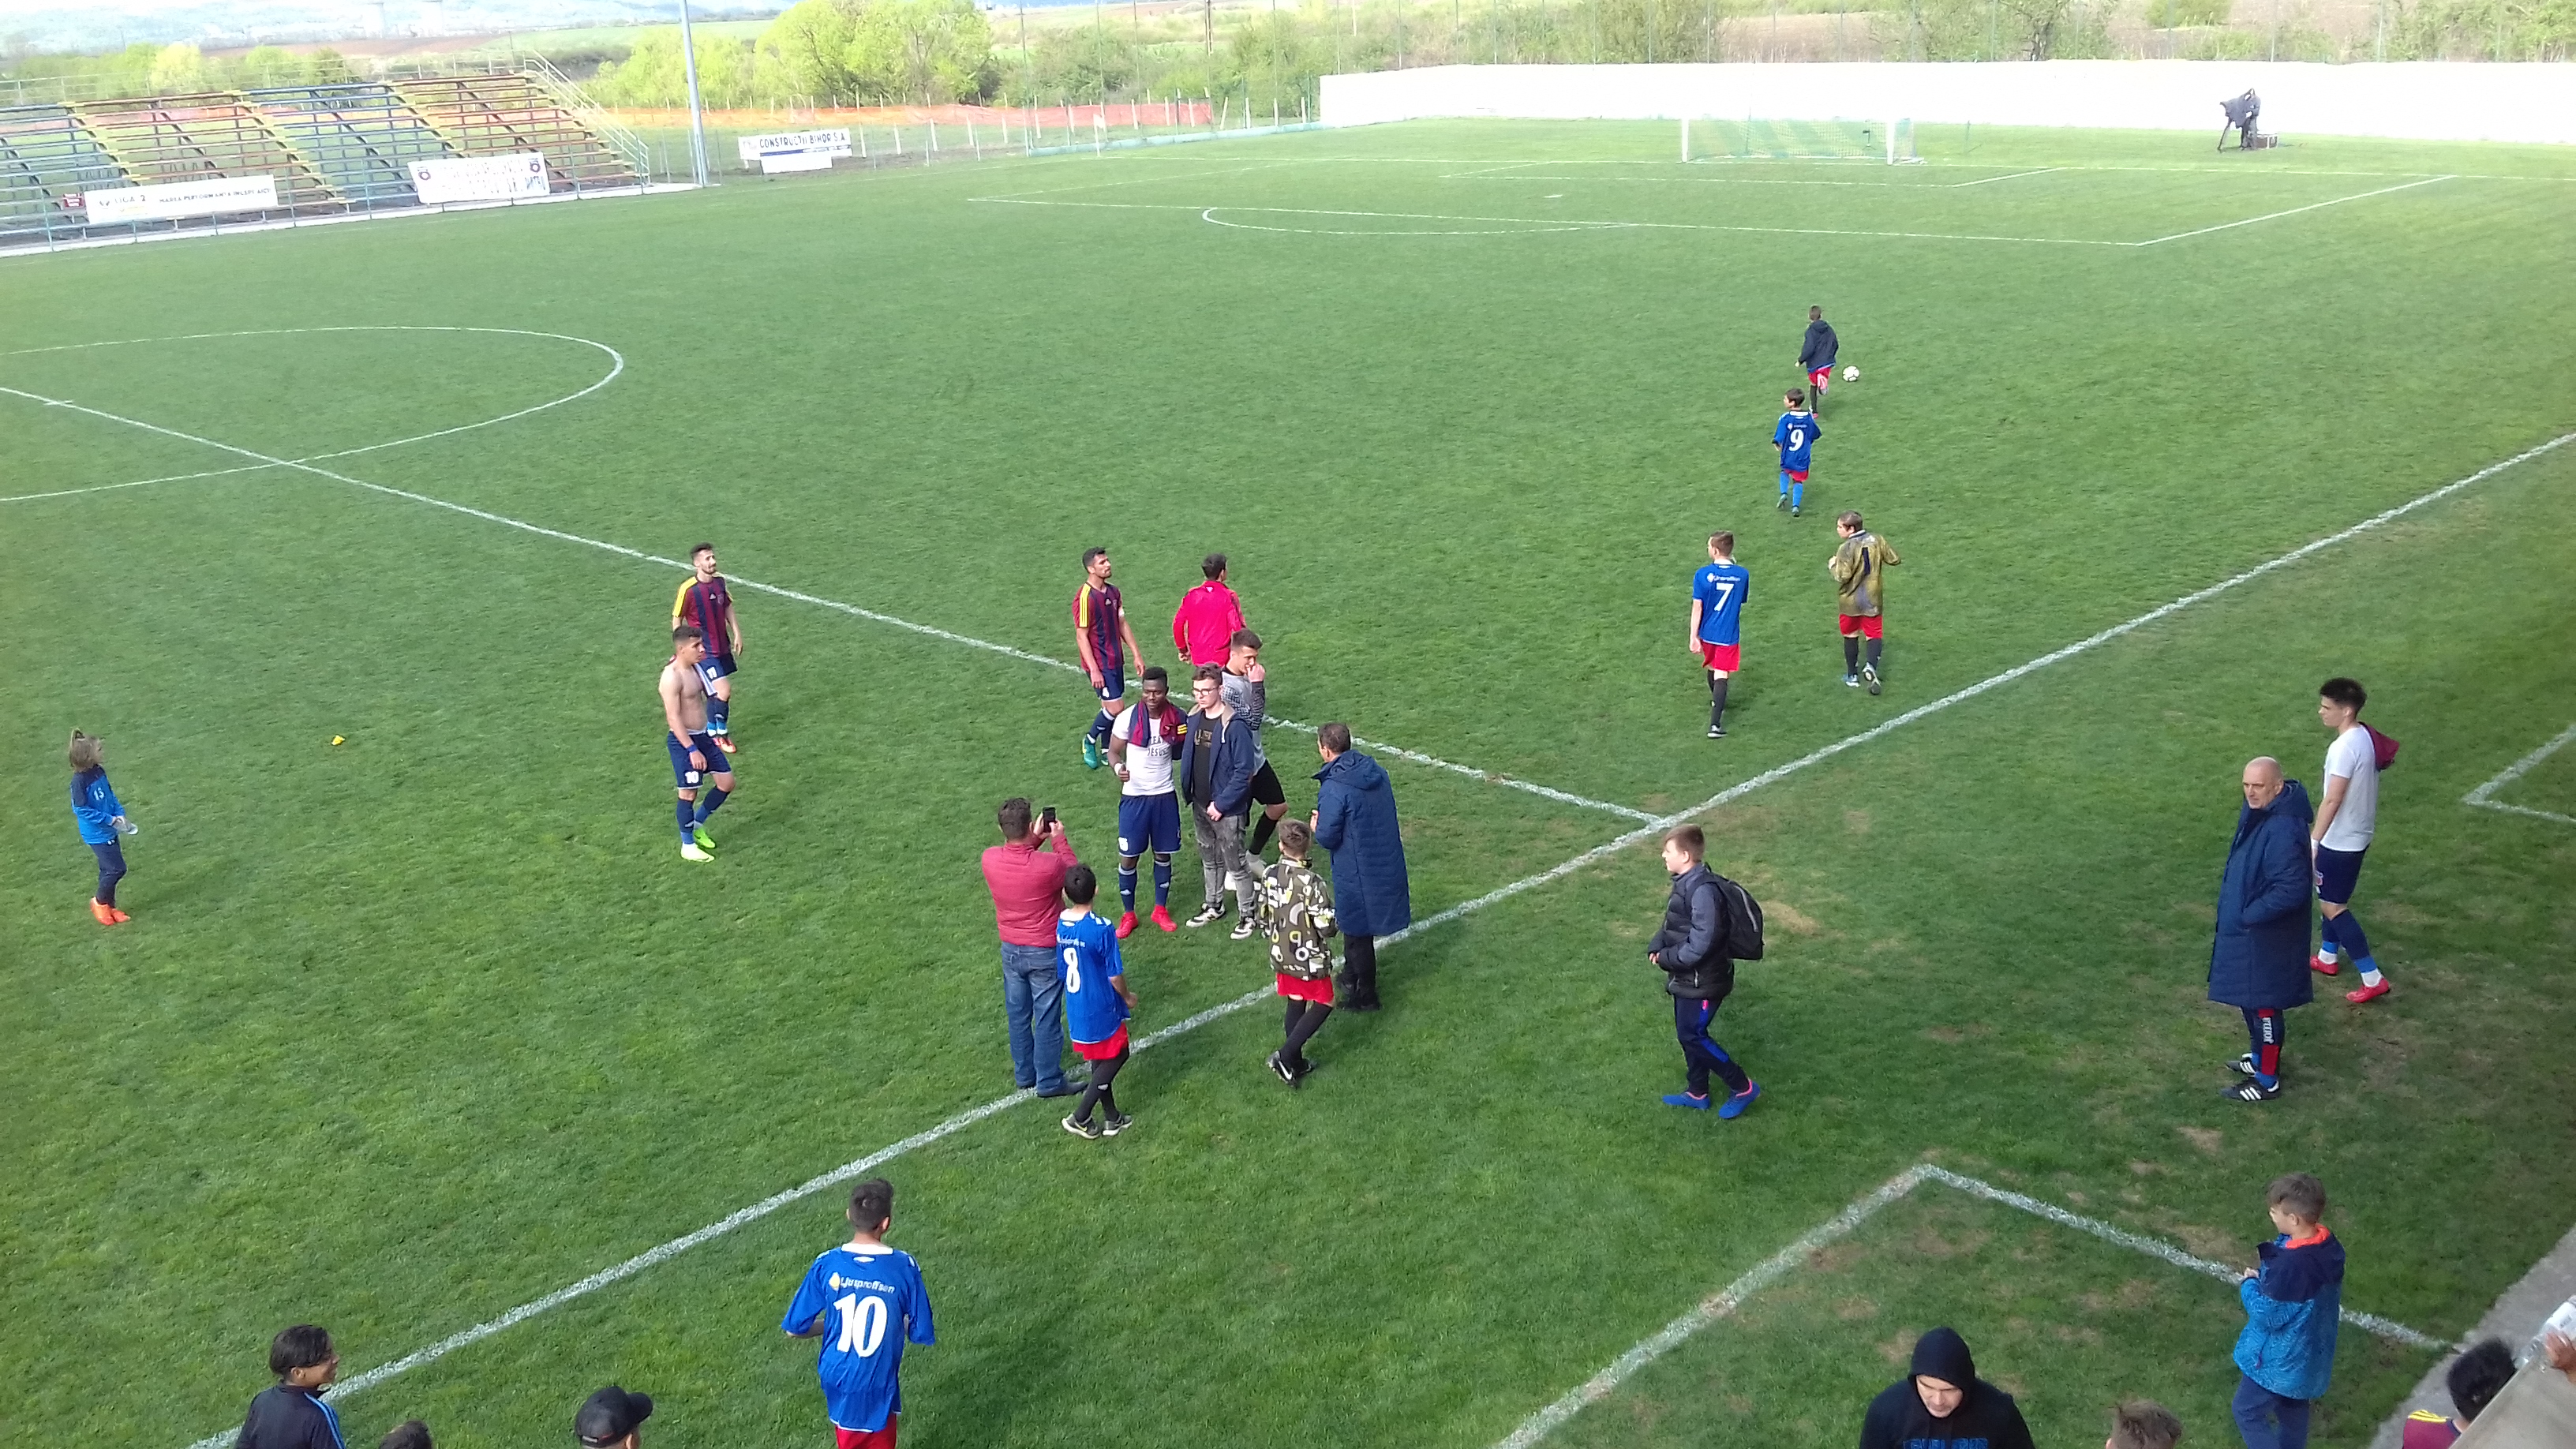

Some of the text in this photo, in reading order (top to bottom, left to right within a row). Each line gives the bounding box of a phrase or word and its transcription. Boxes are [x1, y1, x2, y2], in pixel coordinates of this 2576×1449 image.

[1788, 429, 1804, 451] 9
[1713, 582, 1735, 612] 7
[684, 770, 699, 784] 10
[1063, 947, 1080, 994] 8
[833, 1292, 888, 1358] 10
